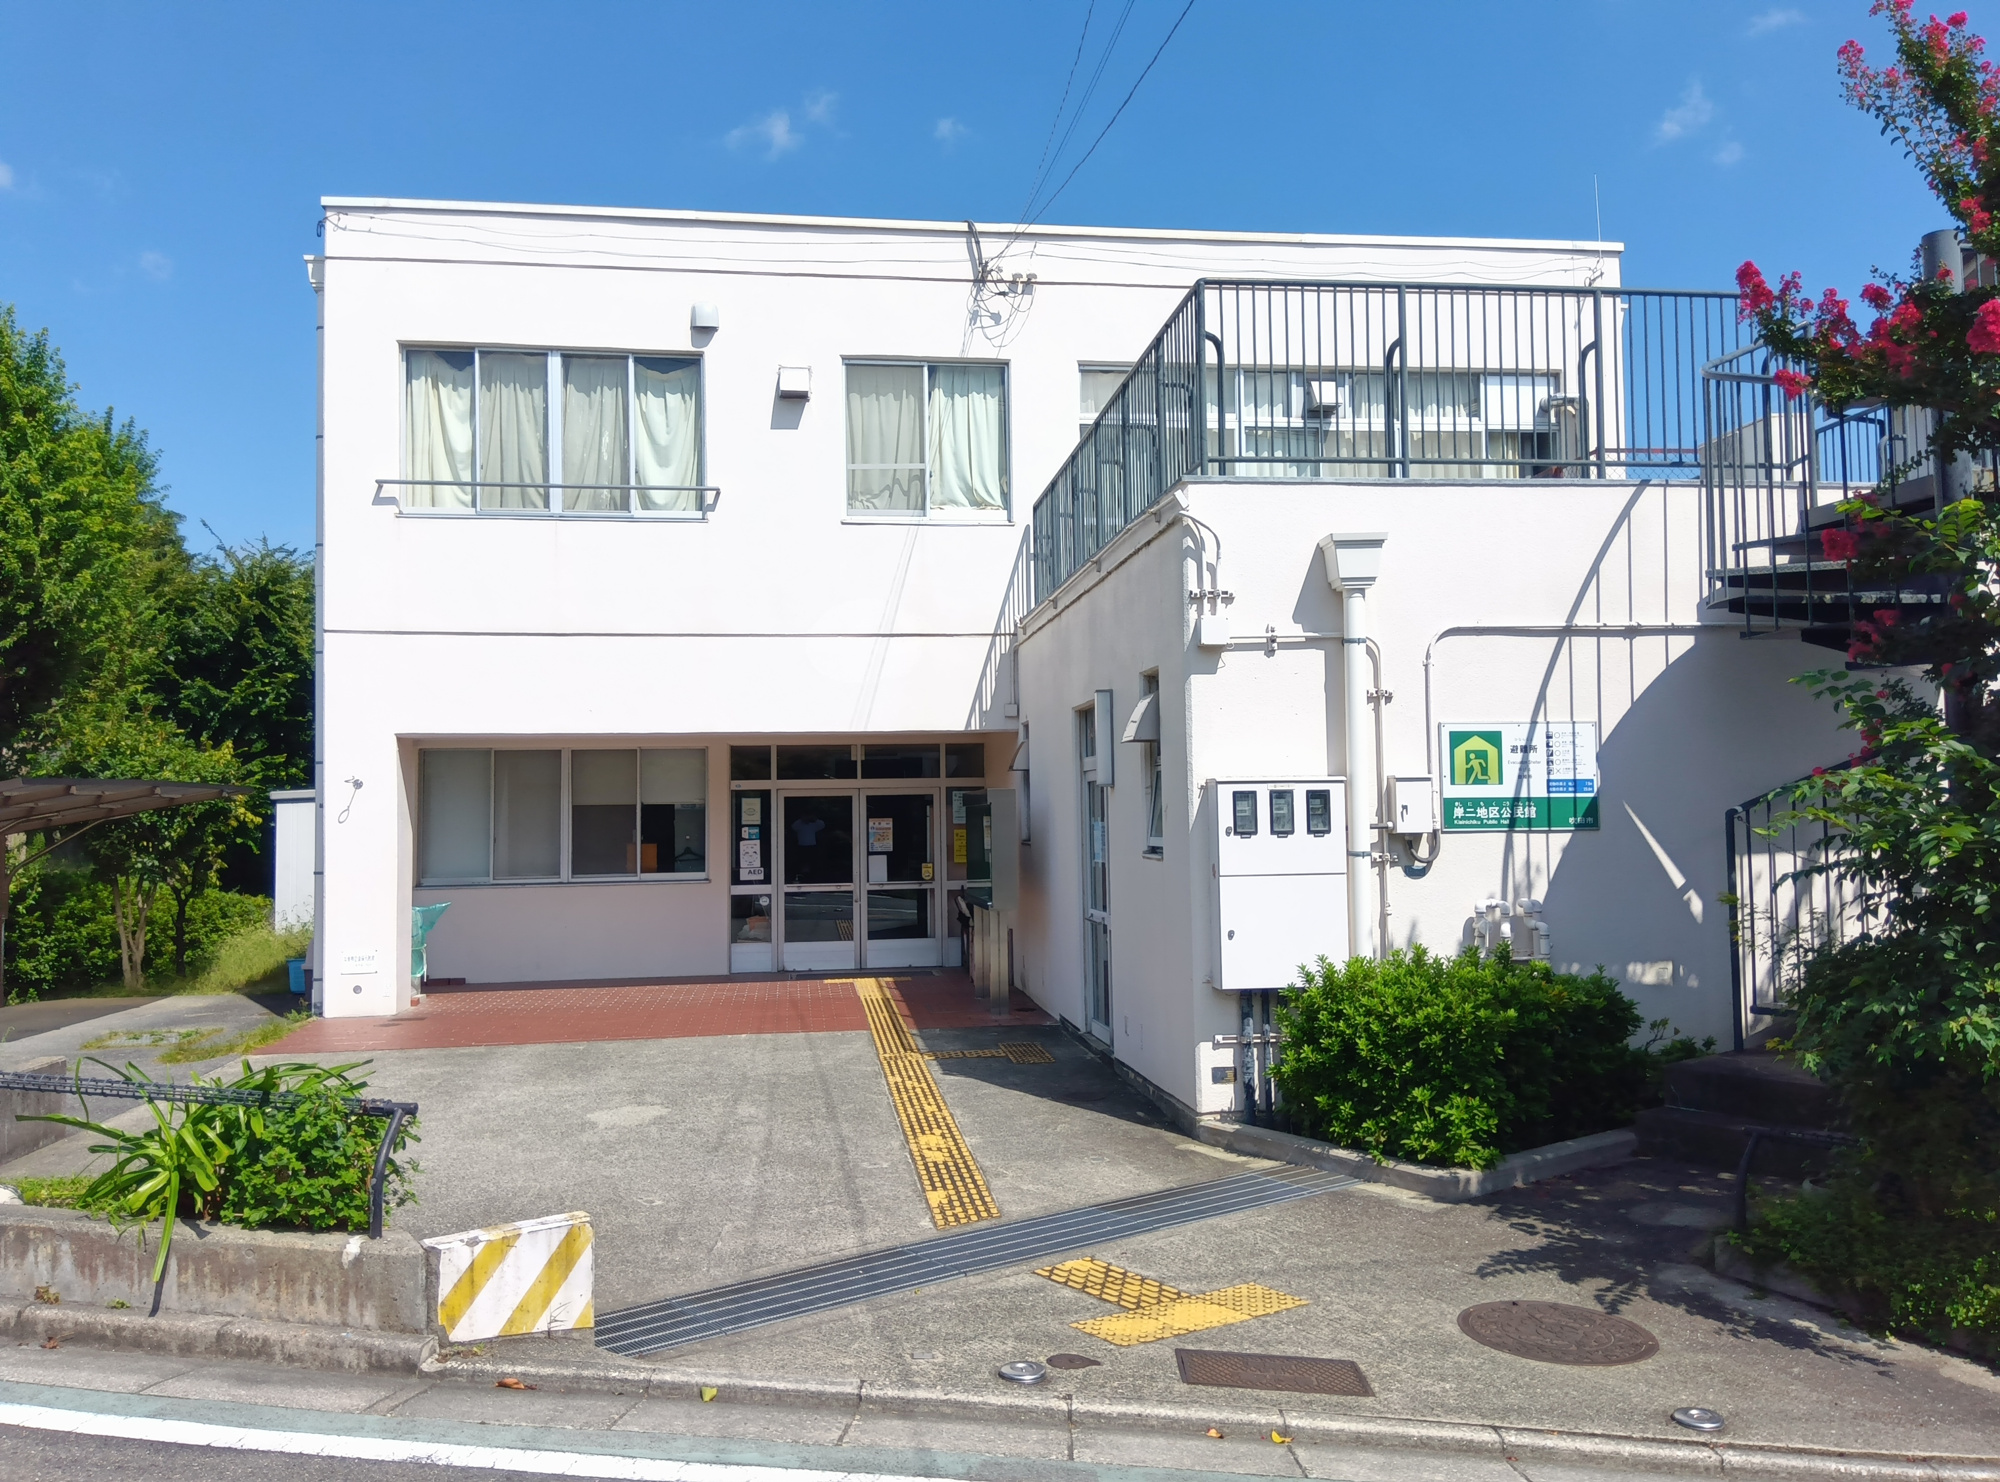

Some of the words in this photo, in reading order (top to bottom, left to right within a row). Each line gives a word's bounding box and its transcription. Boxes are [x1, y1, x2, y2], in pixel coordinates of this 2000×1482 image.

[1509, 744, 1538, 754] 避難所
[1453, 806, 1537, 819] 岸二地区公民館
